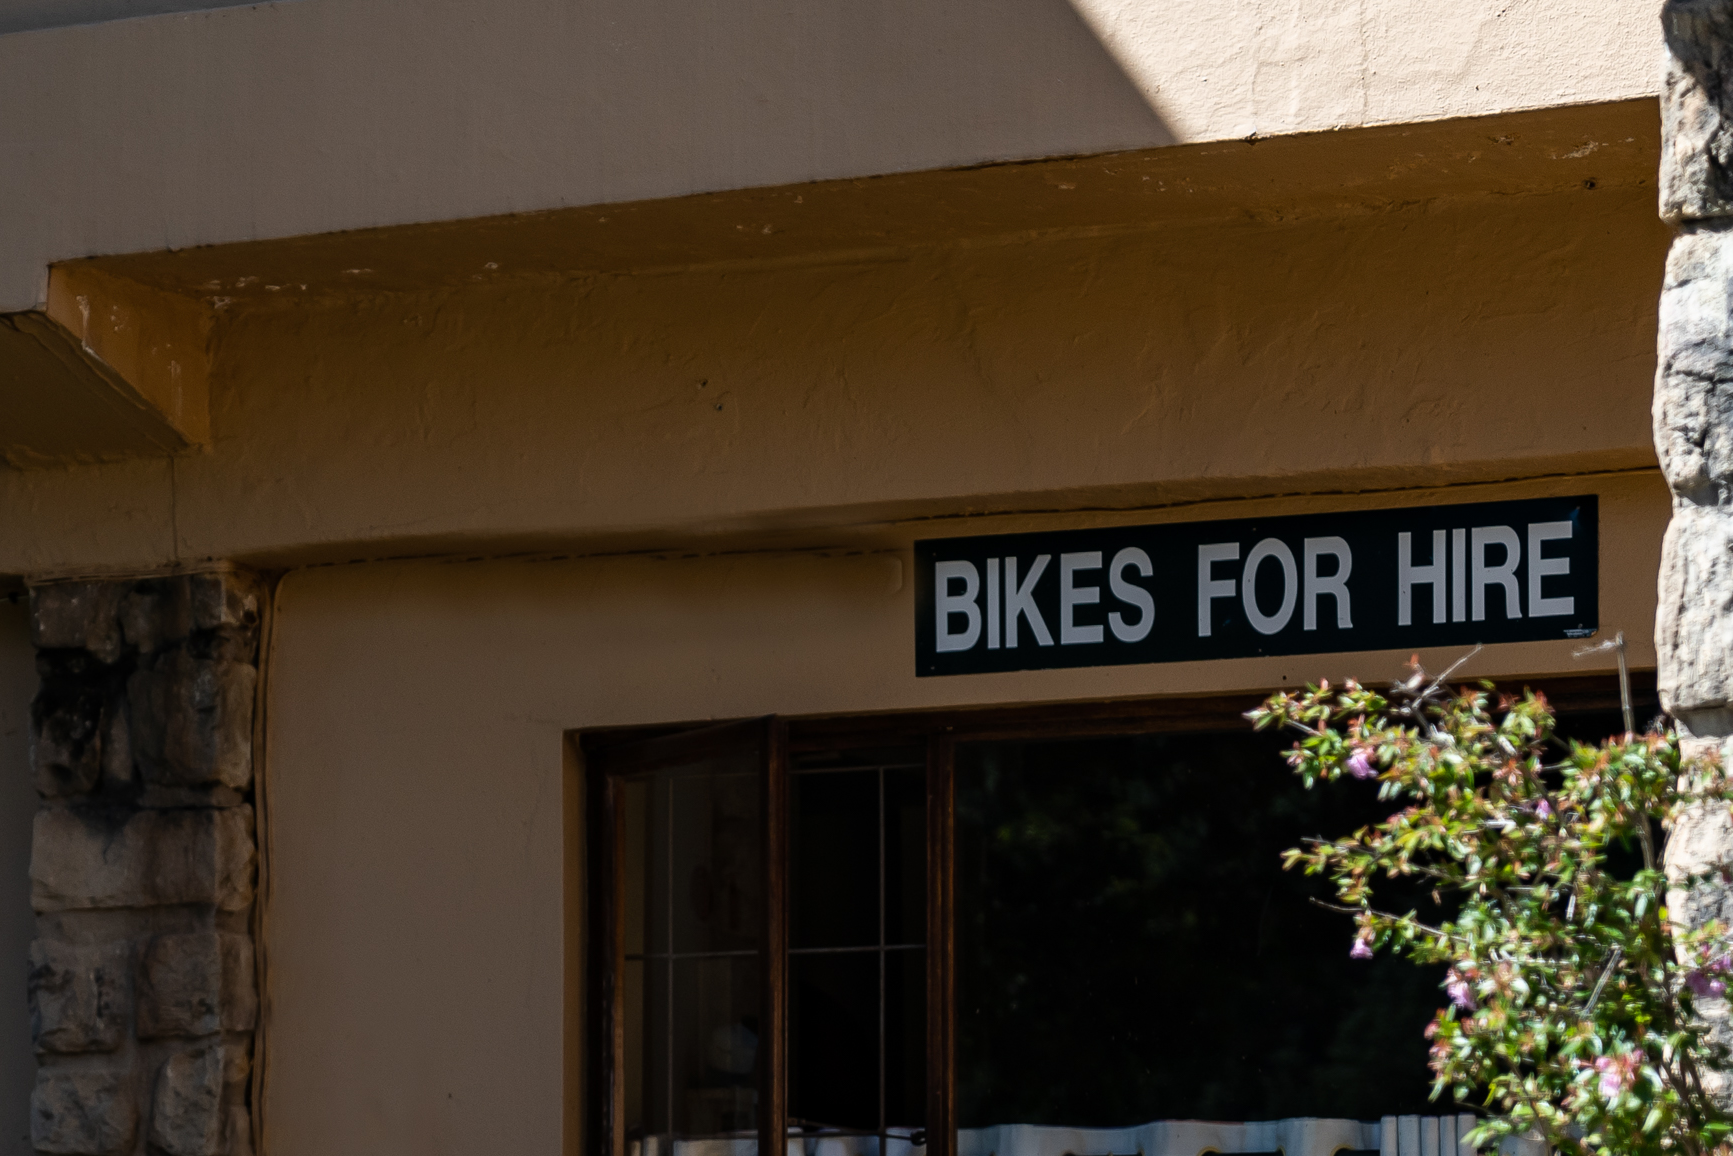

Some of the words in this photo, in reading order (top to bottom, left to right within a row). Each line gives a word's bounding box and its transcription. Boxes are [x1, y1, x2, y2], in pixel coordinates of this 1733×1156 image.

[934, 546, 1155, 653] BIKES
[1197, 535, 1353, 637] FOR
[1397, 520, 1575, 626] HIRE
